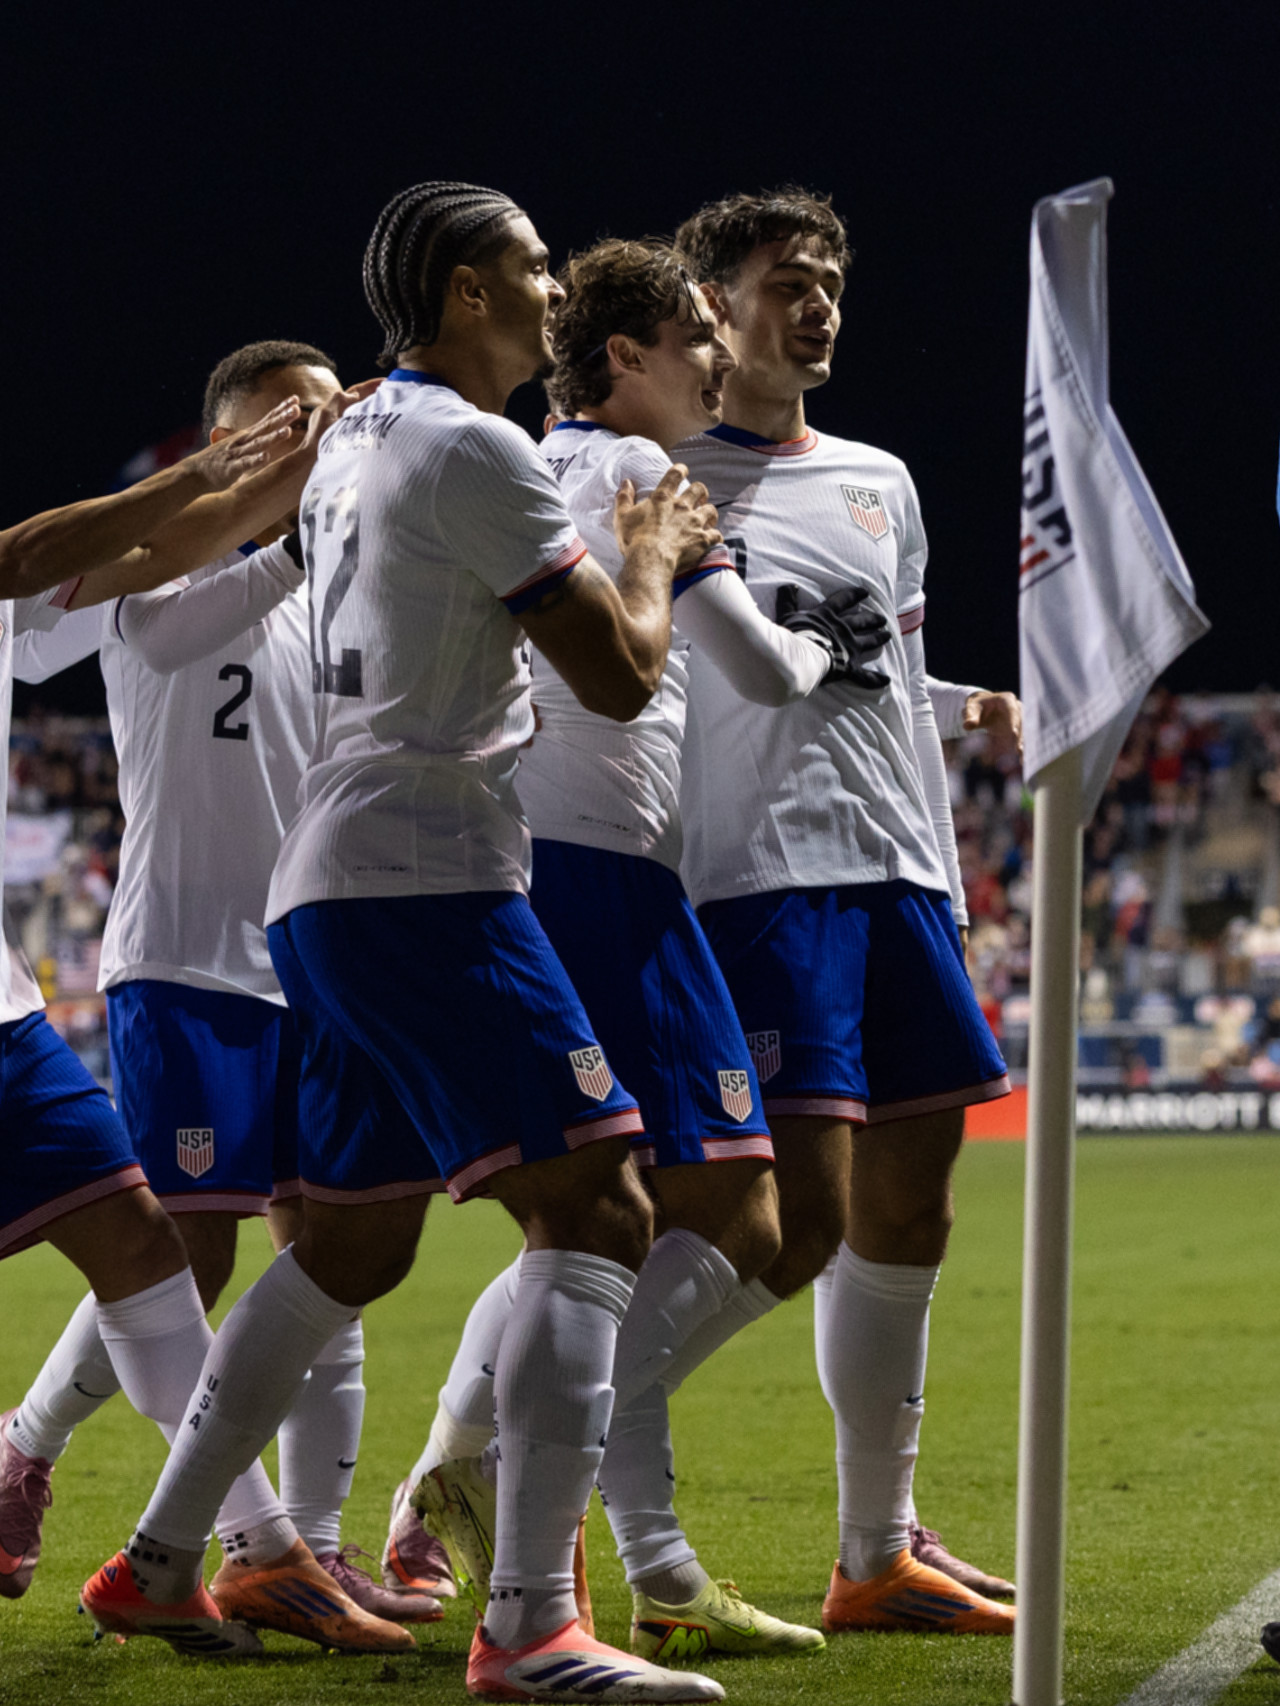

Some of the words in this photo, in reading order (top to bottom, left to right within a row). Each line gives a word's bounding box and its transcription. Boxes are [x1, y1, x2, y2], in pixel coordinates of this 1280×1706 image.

[845, 488, 880, 510] USA
[212, 663, 253, 741] 2
[747, 1032, 778, 1054] USA
[571, 1048, 603, 1072] USA
[720, 1072, 747, 1093] USA
[179, 1130, 212, 1150] USA
[189, 1373, 220, 1431] USA
